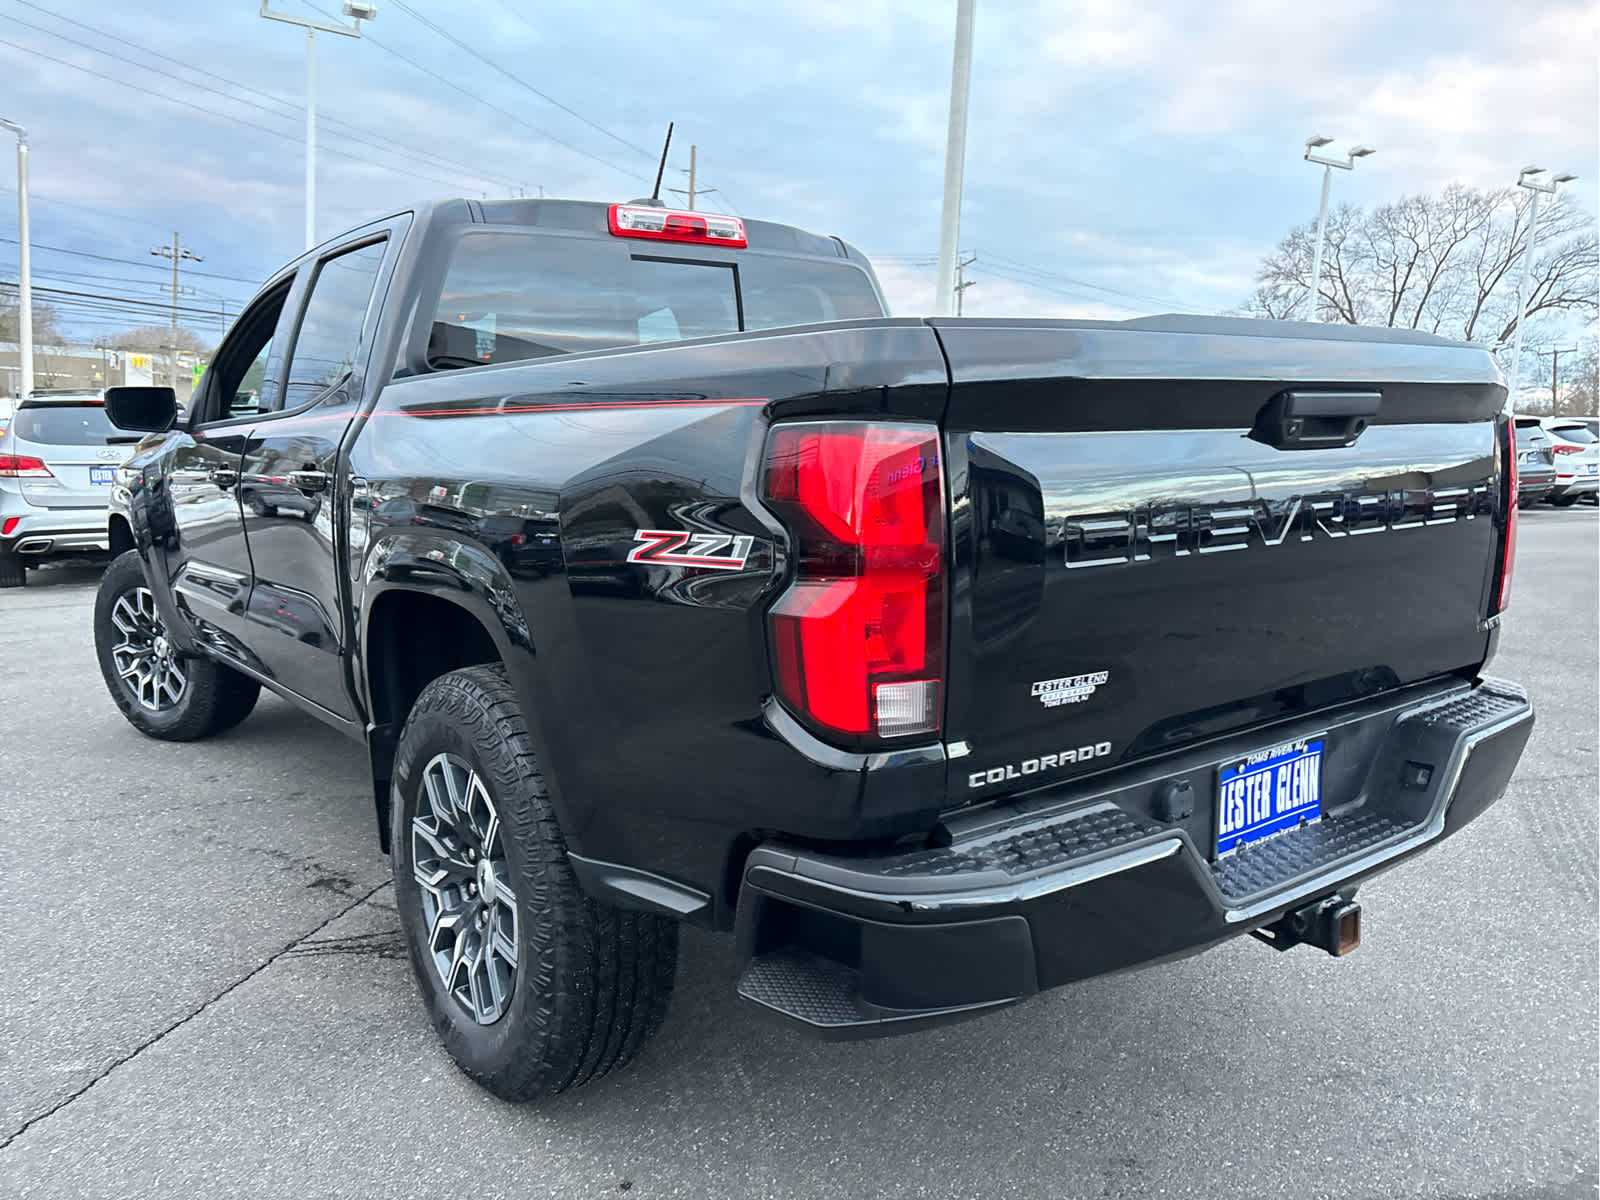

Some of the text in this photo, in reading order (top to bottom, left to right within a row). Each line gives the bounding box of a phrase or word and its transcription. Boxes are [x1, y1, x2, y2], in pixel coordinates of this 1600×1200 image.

[626, 529, 754, 570] Z71
[1065, 486, 1489, 568] CHEVROLET
[1033, 673, 1107, 693] LESTER GLENN
[968, 741, 1111, 788] COLORADO
[1219, 755, 1321, 835] LESTER GLENN
